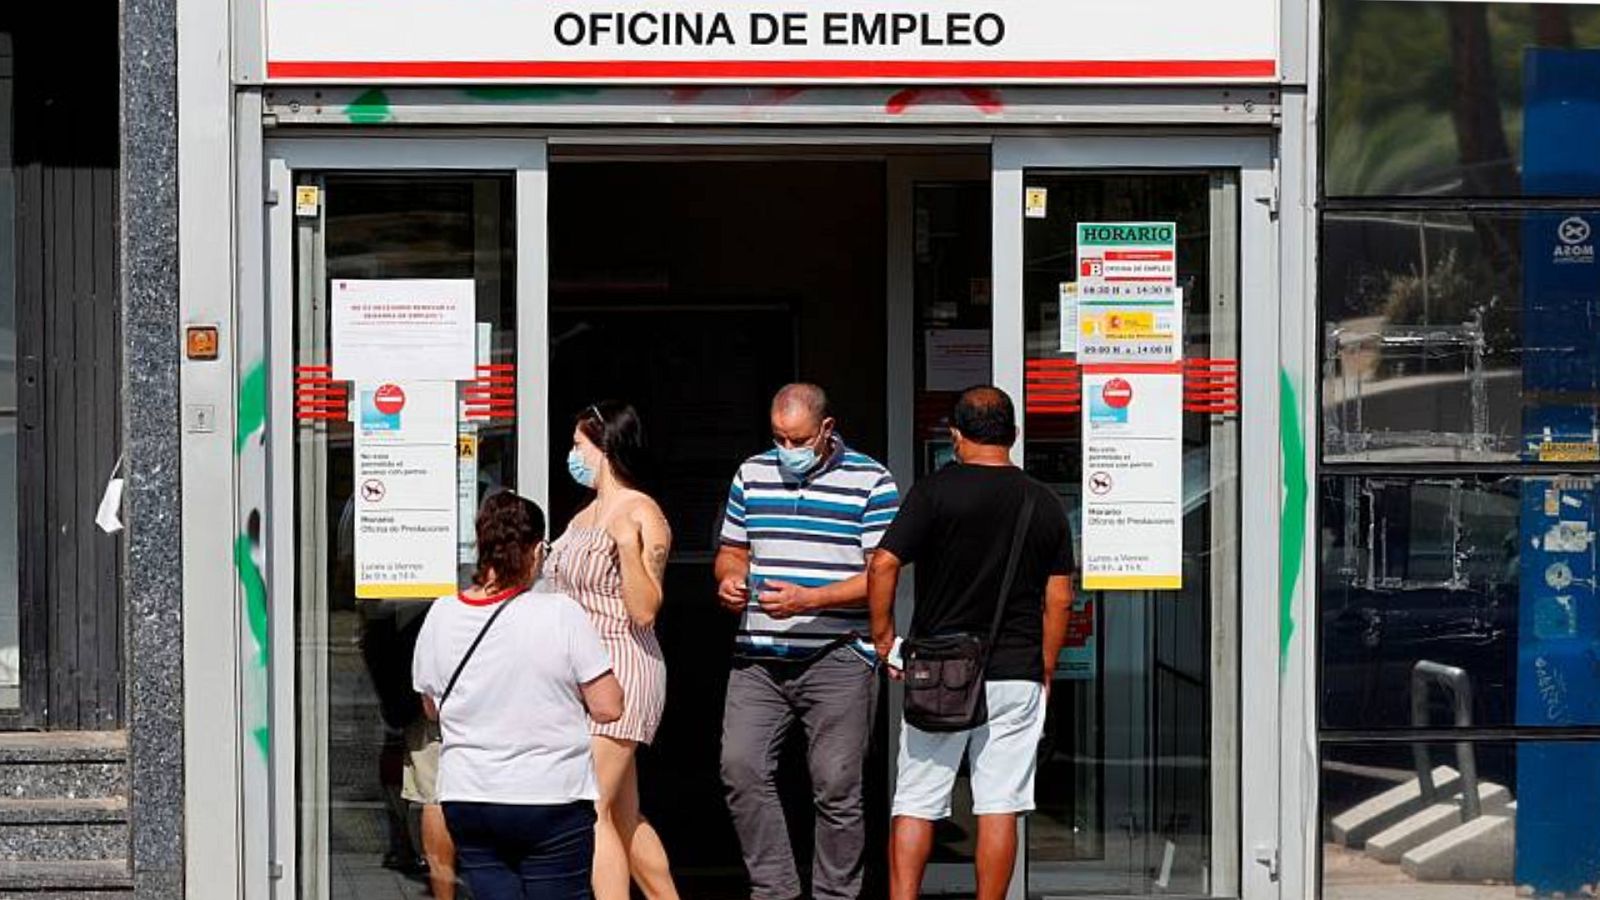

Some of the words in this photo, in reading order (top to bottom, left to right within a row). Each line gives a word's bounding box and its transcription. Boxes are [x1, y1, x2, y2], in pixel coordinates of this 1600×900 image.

[554, 12, 735, 46] OFICINA
[750, 12, 807, 46] DE
[824, 12, 1006, 46] EMPLEO
[1084, 227, 1172, 241] HORARIO
